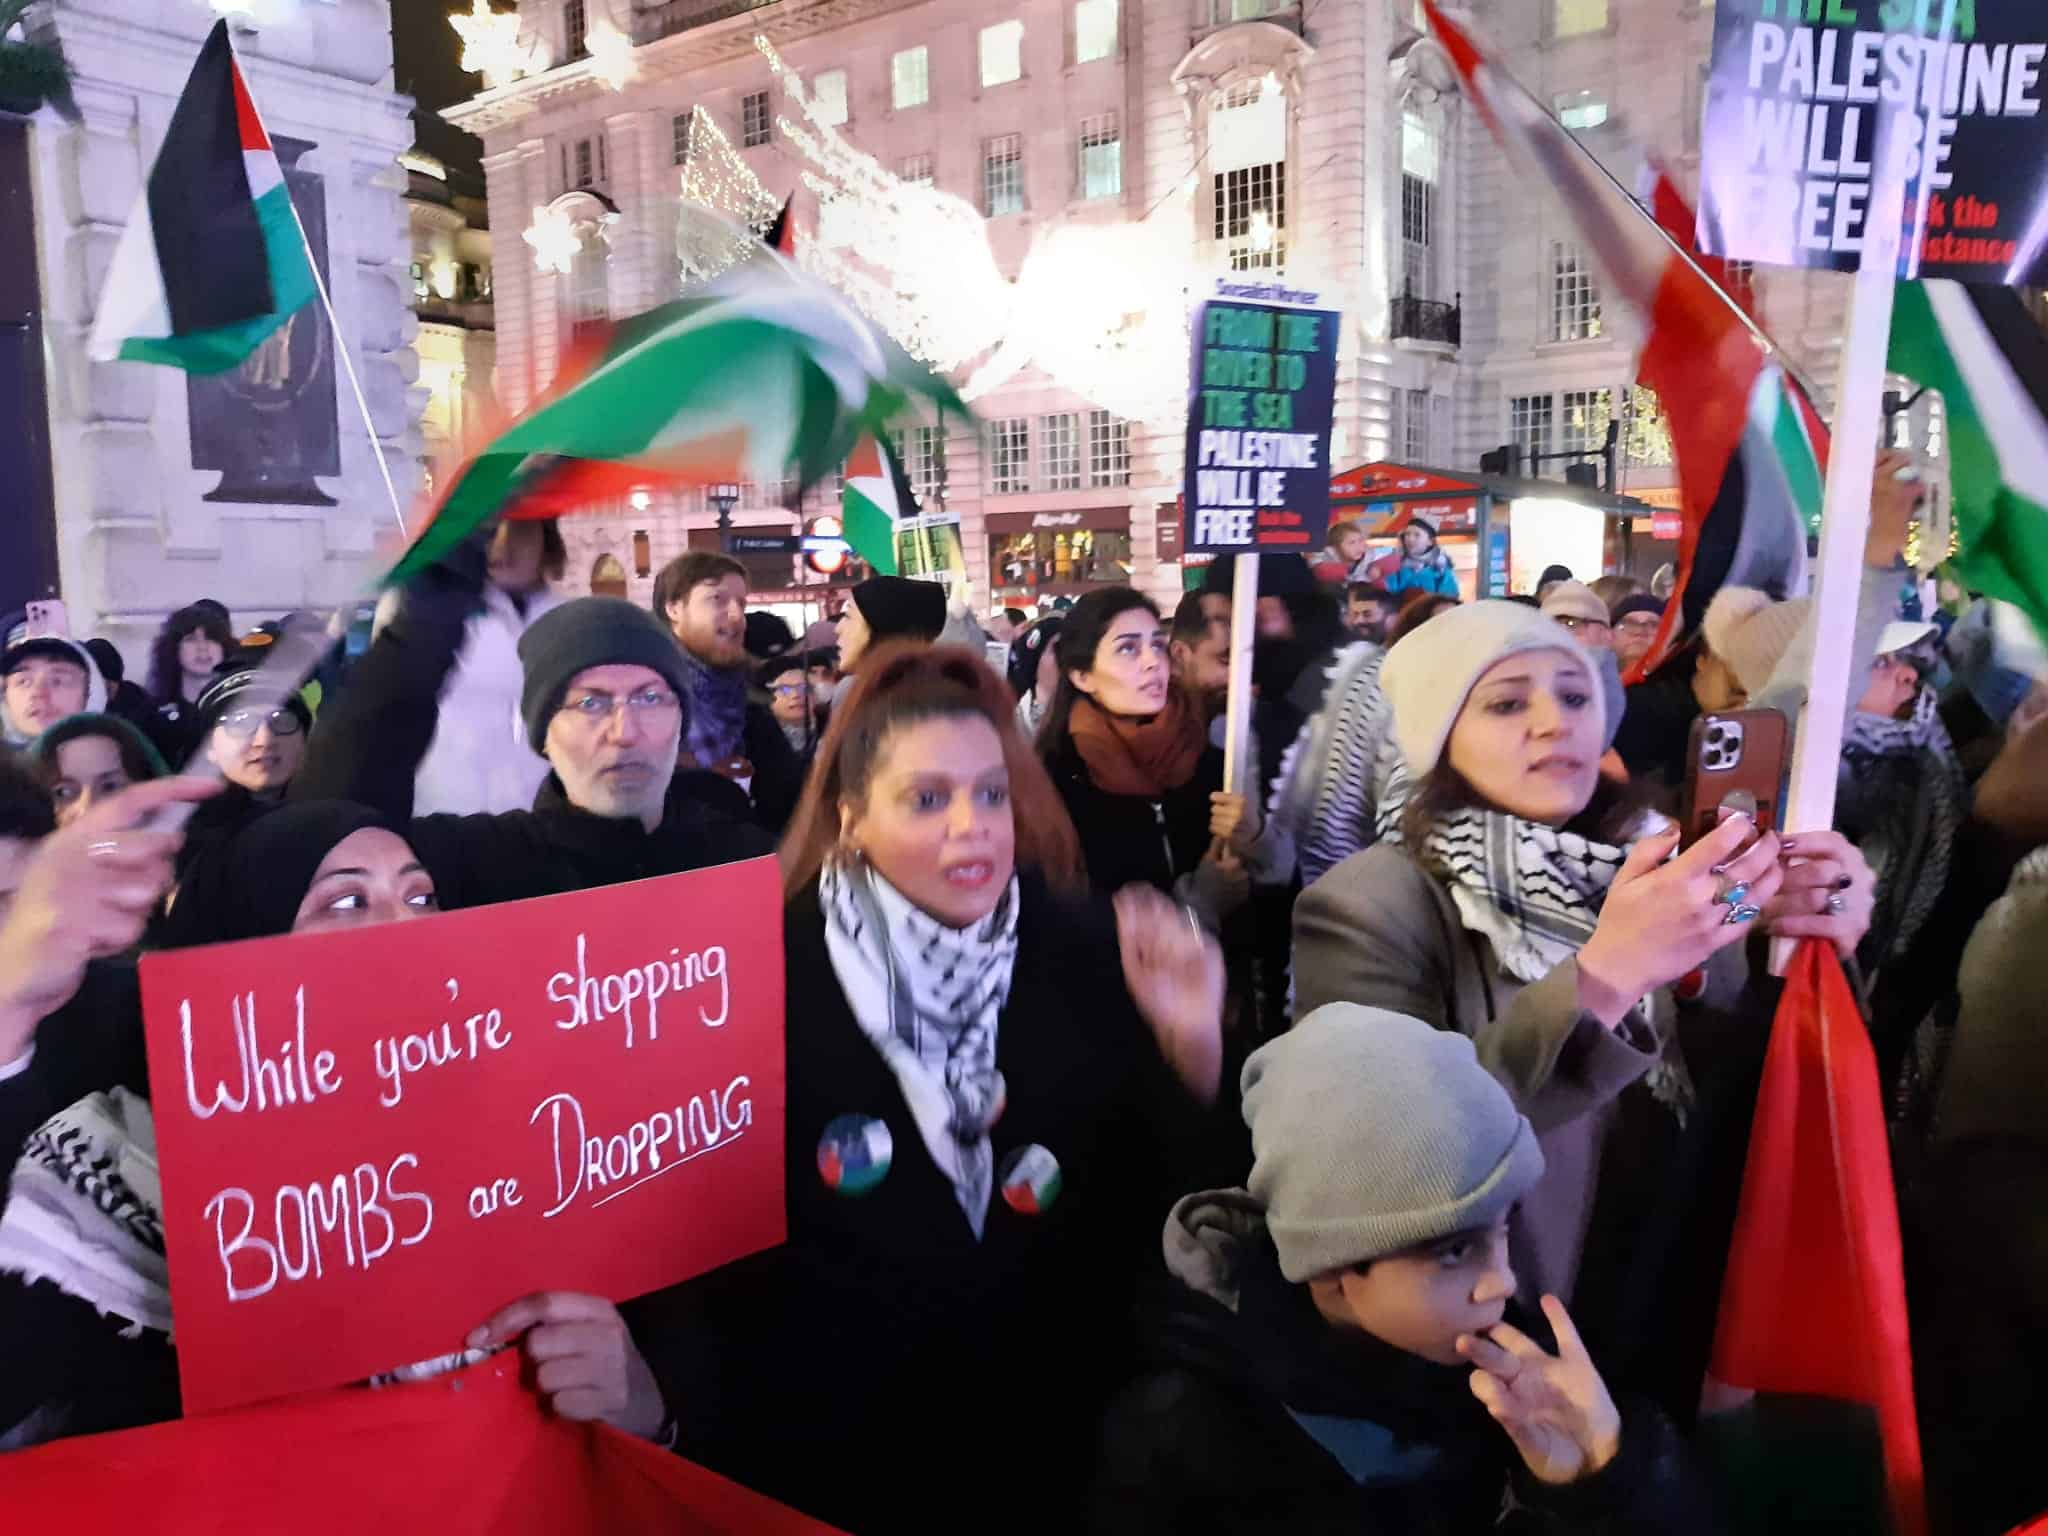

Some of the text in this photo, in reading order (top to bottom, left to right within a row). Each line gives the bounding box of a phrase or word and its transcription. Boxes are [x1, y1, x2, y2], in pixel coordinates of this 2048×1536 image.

[1748, 21, 2046, 116] PALESTINE
[1744, 96, 1958, 189] WILL BE
[1953, 193, 1998, 228] the
[1203, 390, 1293, 429] THE SEA
[1198, 430, 1319, 468] PALESTINE
[1196, 470, 1286, 506] WILL BE
[1195, 508, 1255, 545] FREE
[180, 984, 342, 1120] While
[375, 977, 512, 1108] you're
[204, 1154, 433, 1301] BOMBS
[468, 1177, 523, 1219] are
